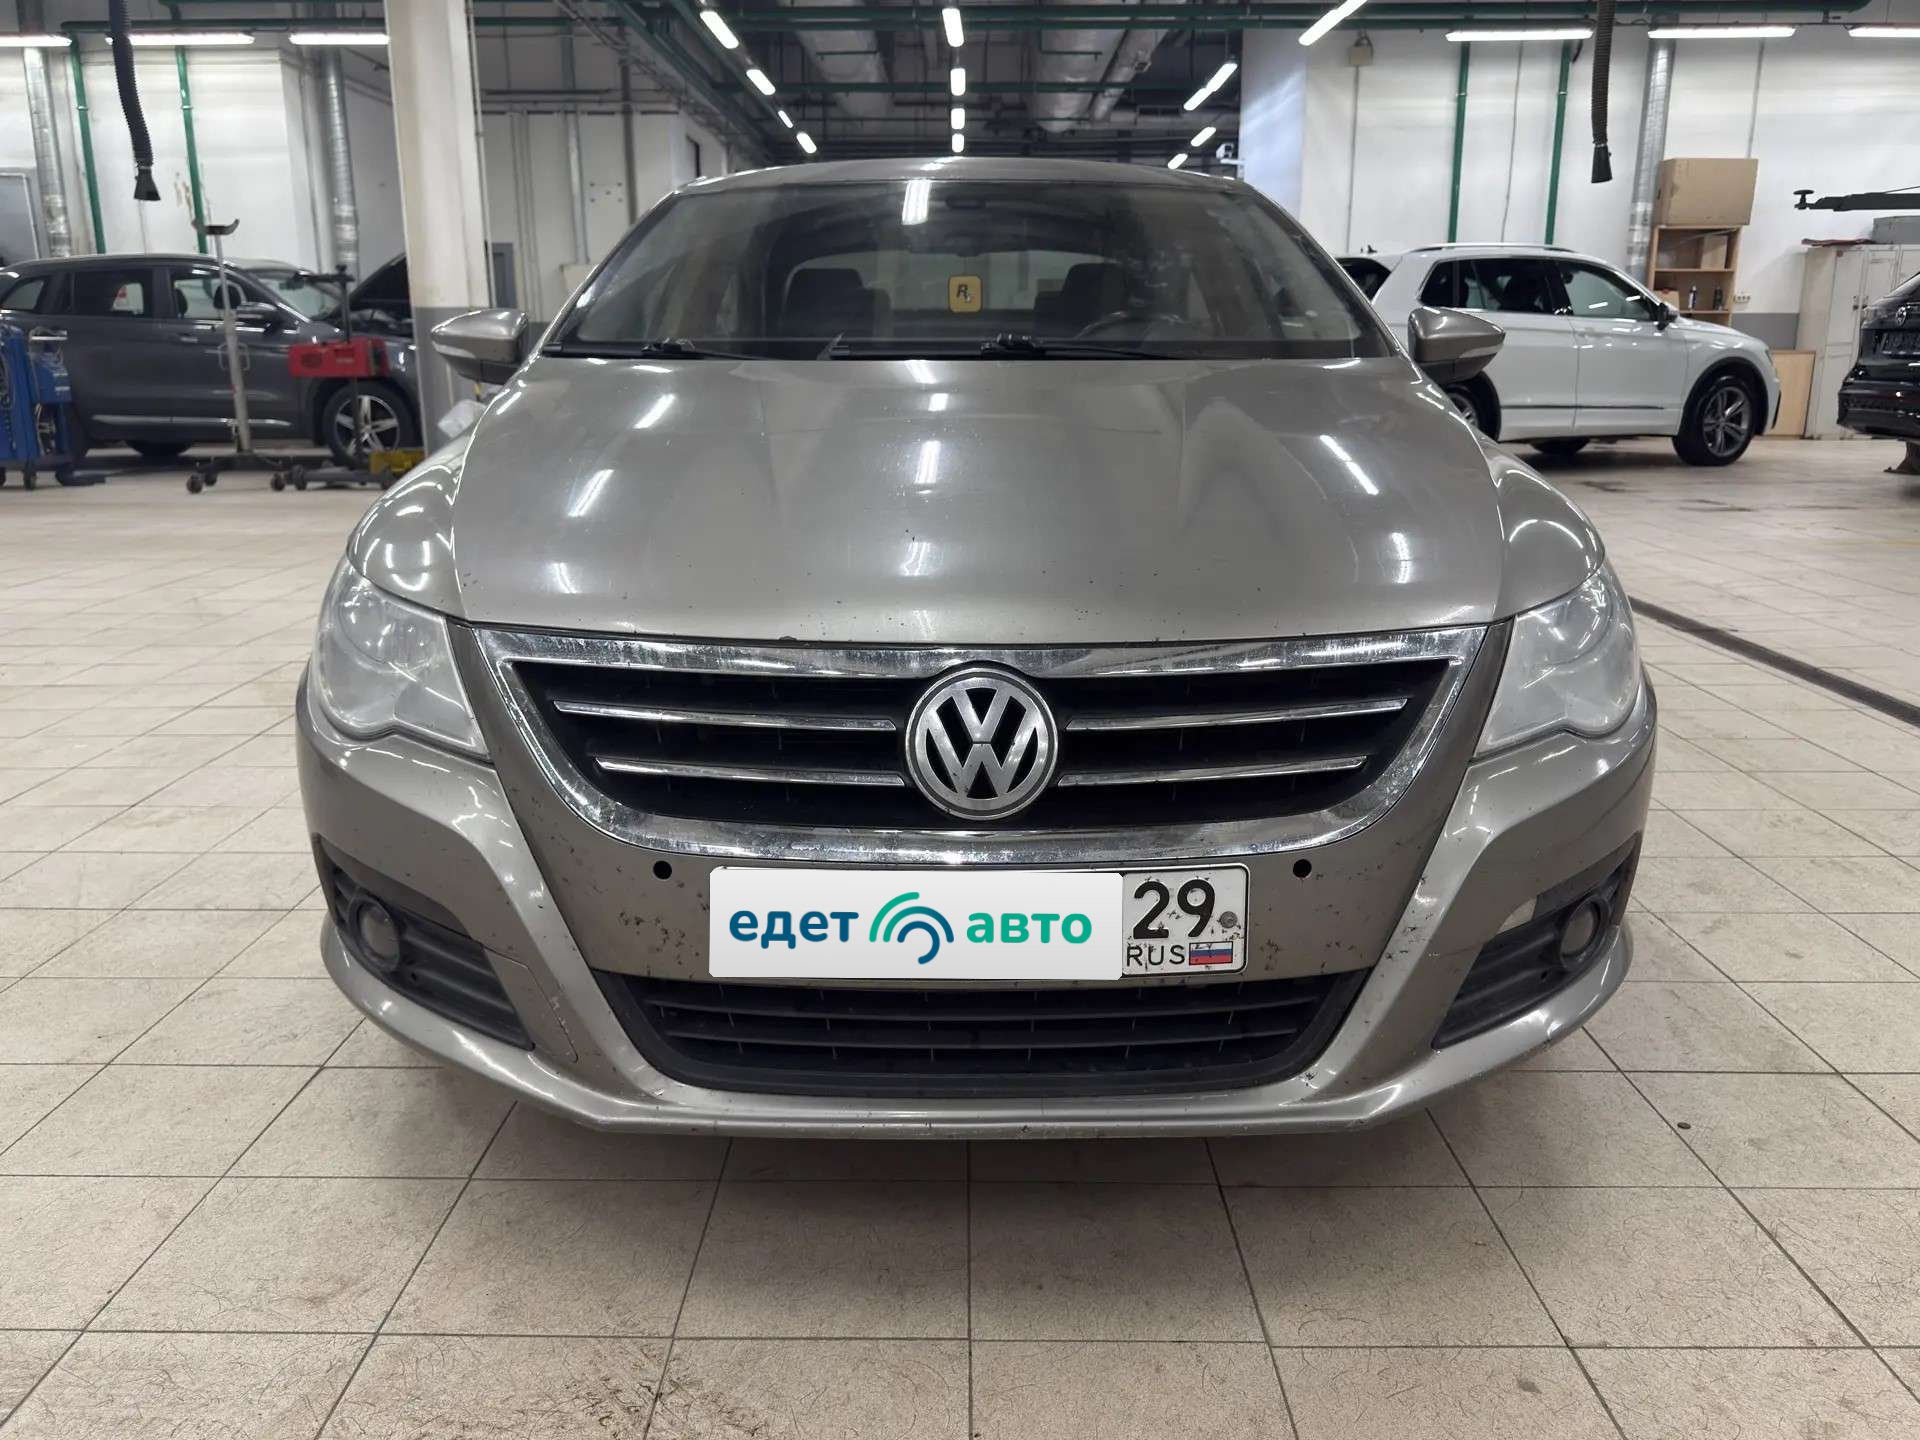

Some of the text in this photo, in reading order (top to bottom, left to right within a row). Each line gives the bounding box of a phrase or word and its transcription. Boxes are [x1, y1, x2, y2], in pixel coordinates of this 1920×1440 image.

[914, 675, 1050, 812] VW
[1132, 879, 1216, 939] 29
[1126, 944, 1186, 967] RUS
